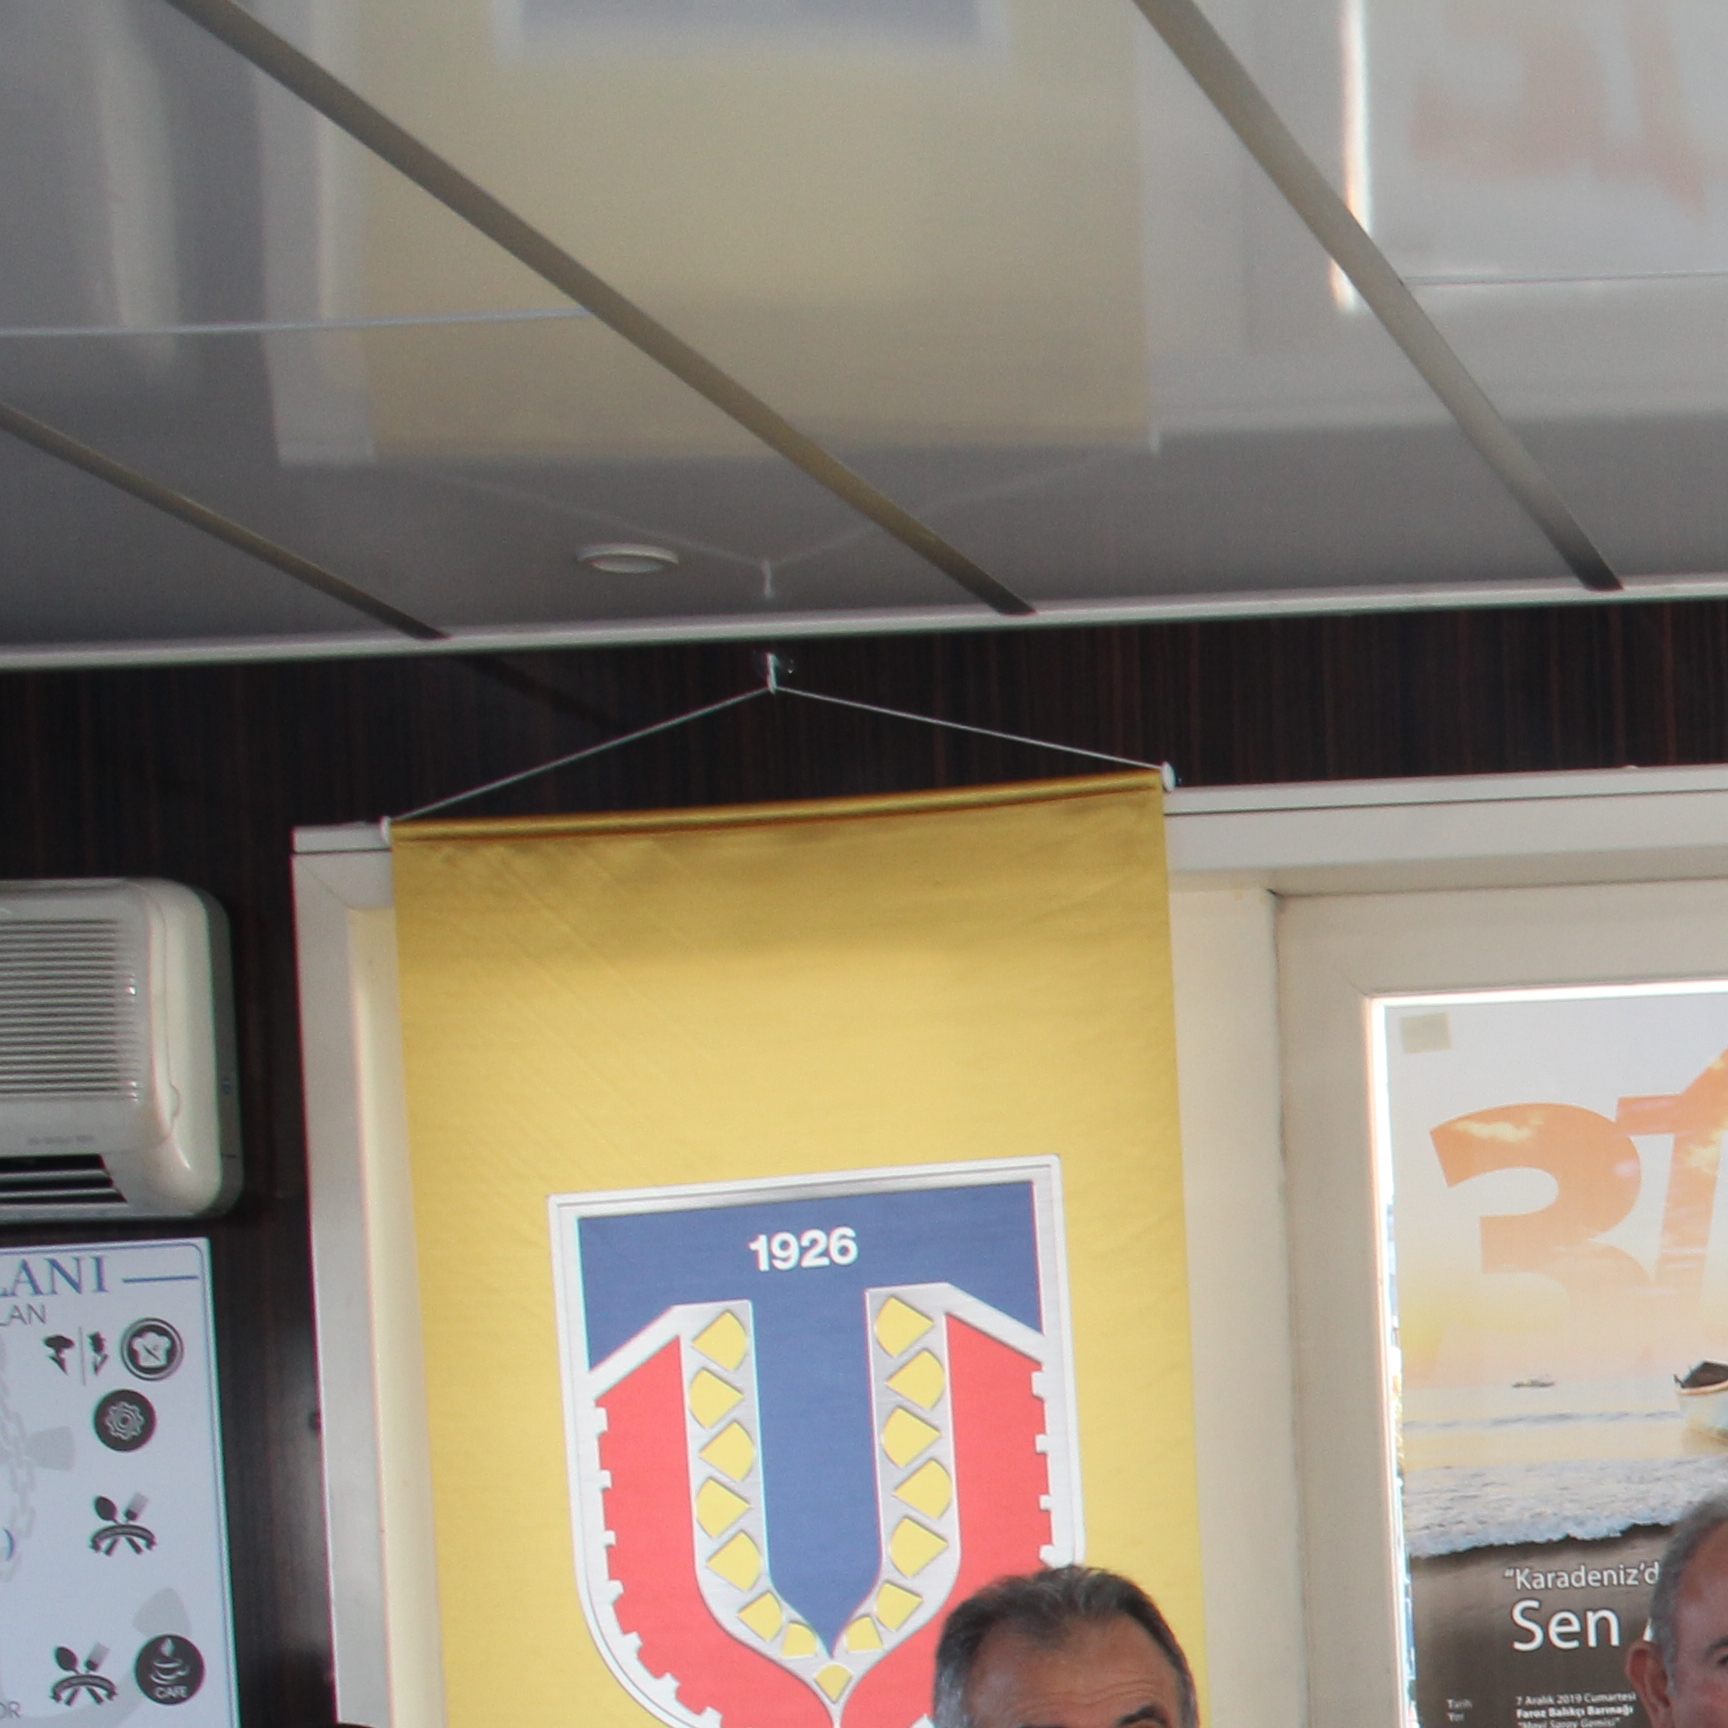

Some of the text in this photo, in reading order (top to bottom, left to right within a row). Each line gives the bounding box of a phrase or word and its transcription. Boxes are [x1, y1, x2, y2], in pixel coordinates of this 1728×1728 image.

[749, 1226, 859, 1273] 1926
[1511, 1600, 1621, 1652] Sen
[154, 1685, 188, 1699] CAFE
[1447, 1699, 1473, 1710] Tarih
[1524, 1695, 1555, 1706] Aralık
[1584, 1691, 1638, 1703] Cumartesi
